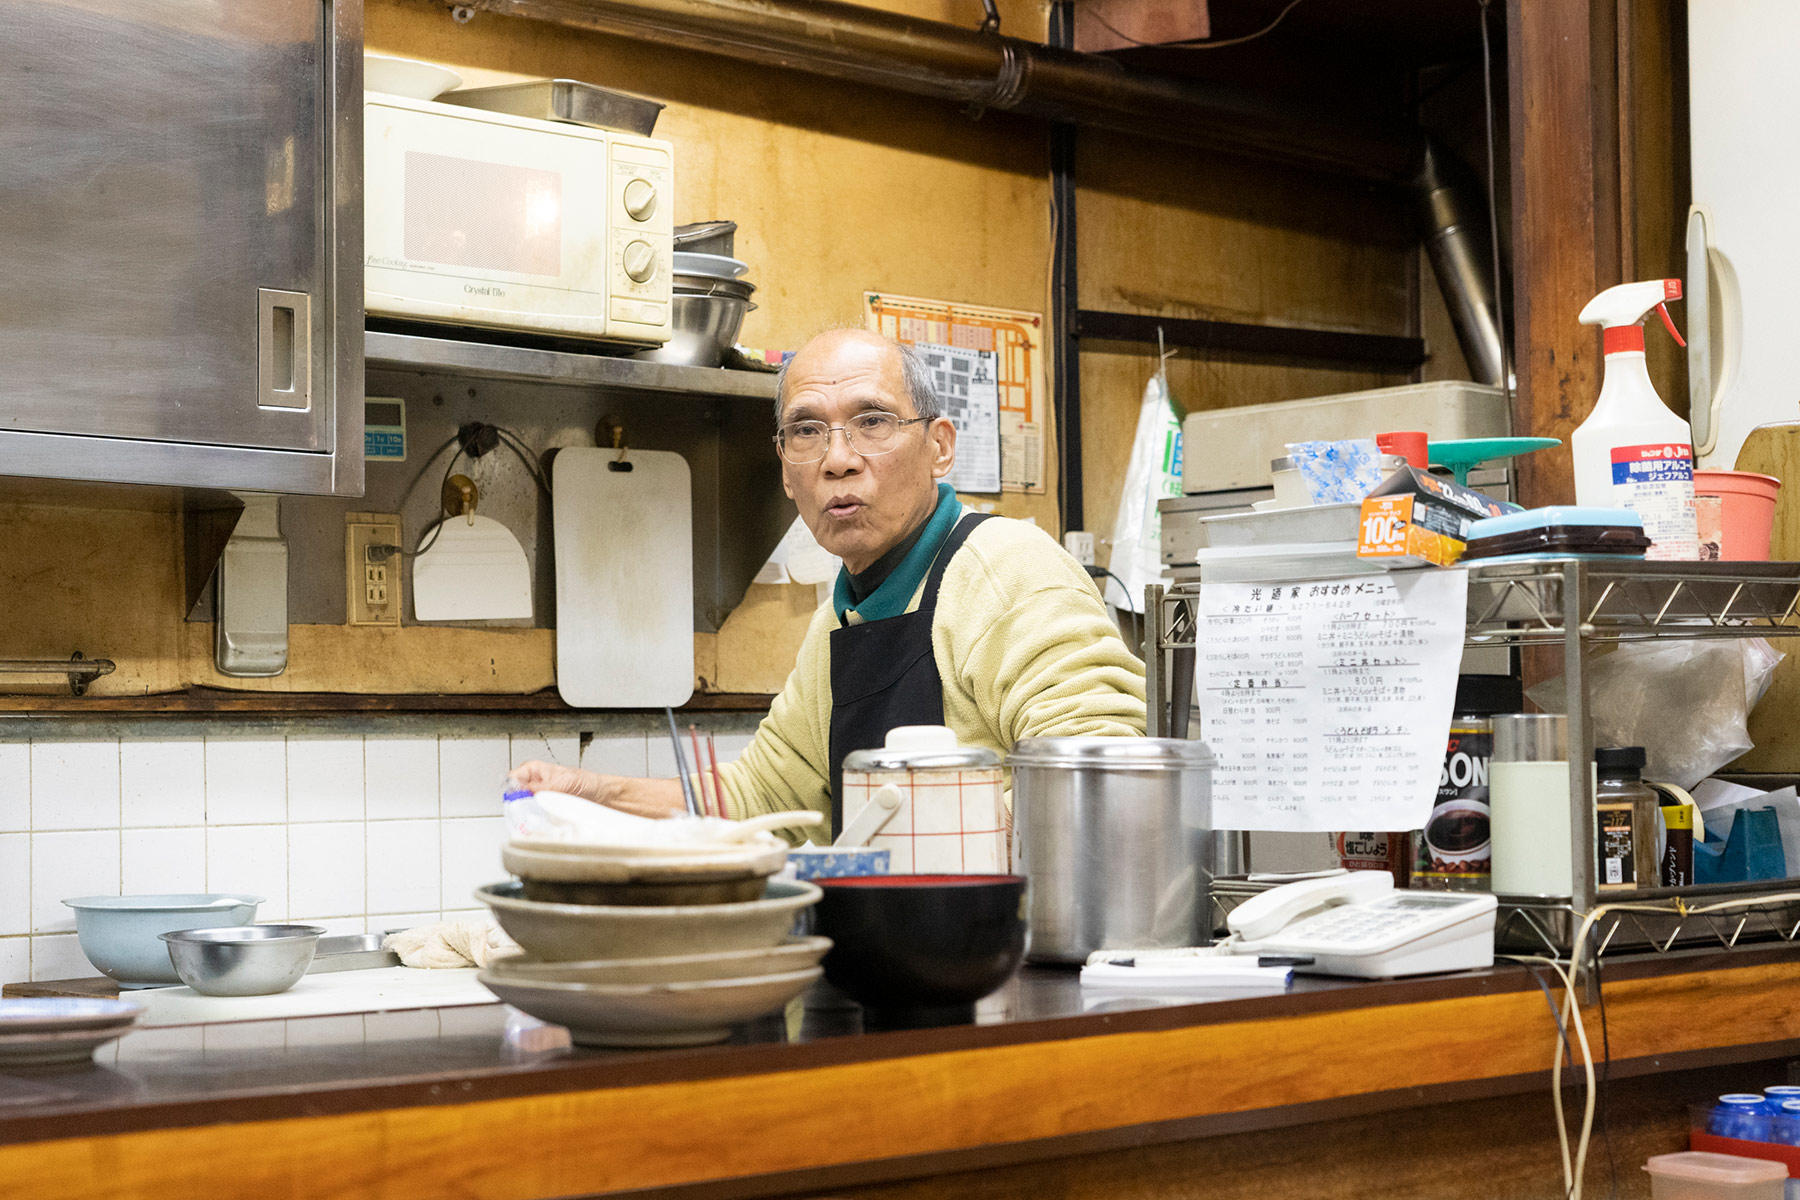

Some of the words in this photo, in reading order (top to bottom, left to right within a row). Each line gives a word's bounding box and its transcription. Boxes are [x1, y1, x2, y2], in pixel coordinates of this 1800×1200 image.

[464, 284, 490, 297] Crystal
[1345, 841, 1388, 857] 塩こしょう
